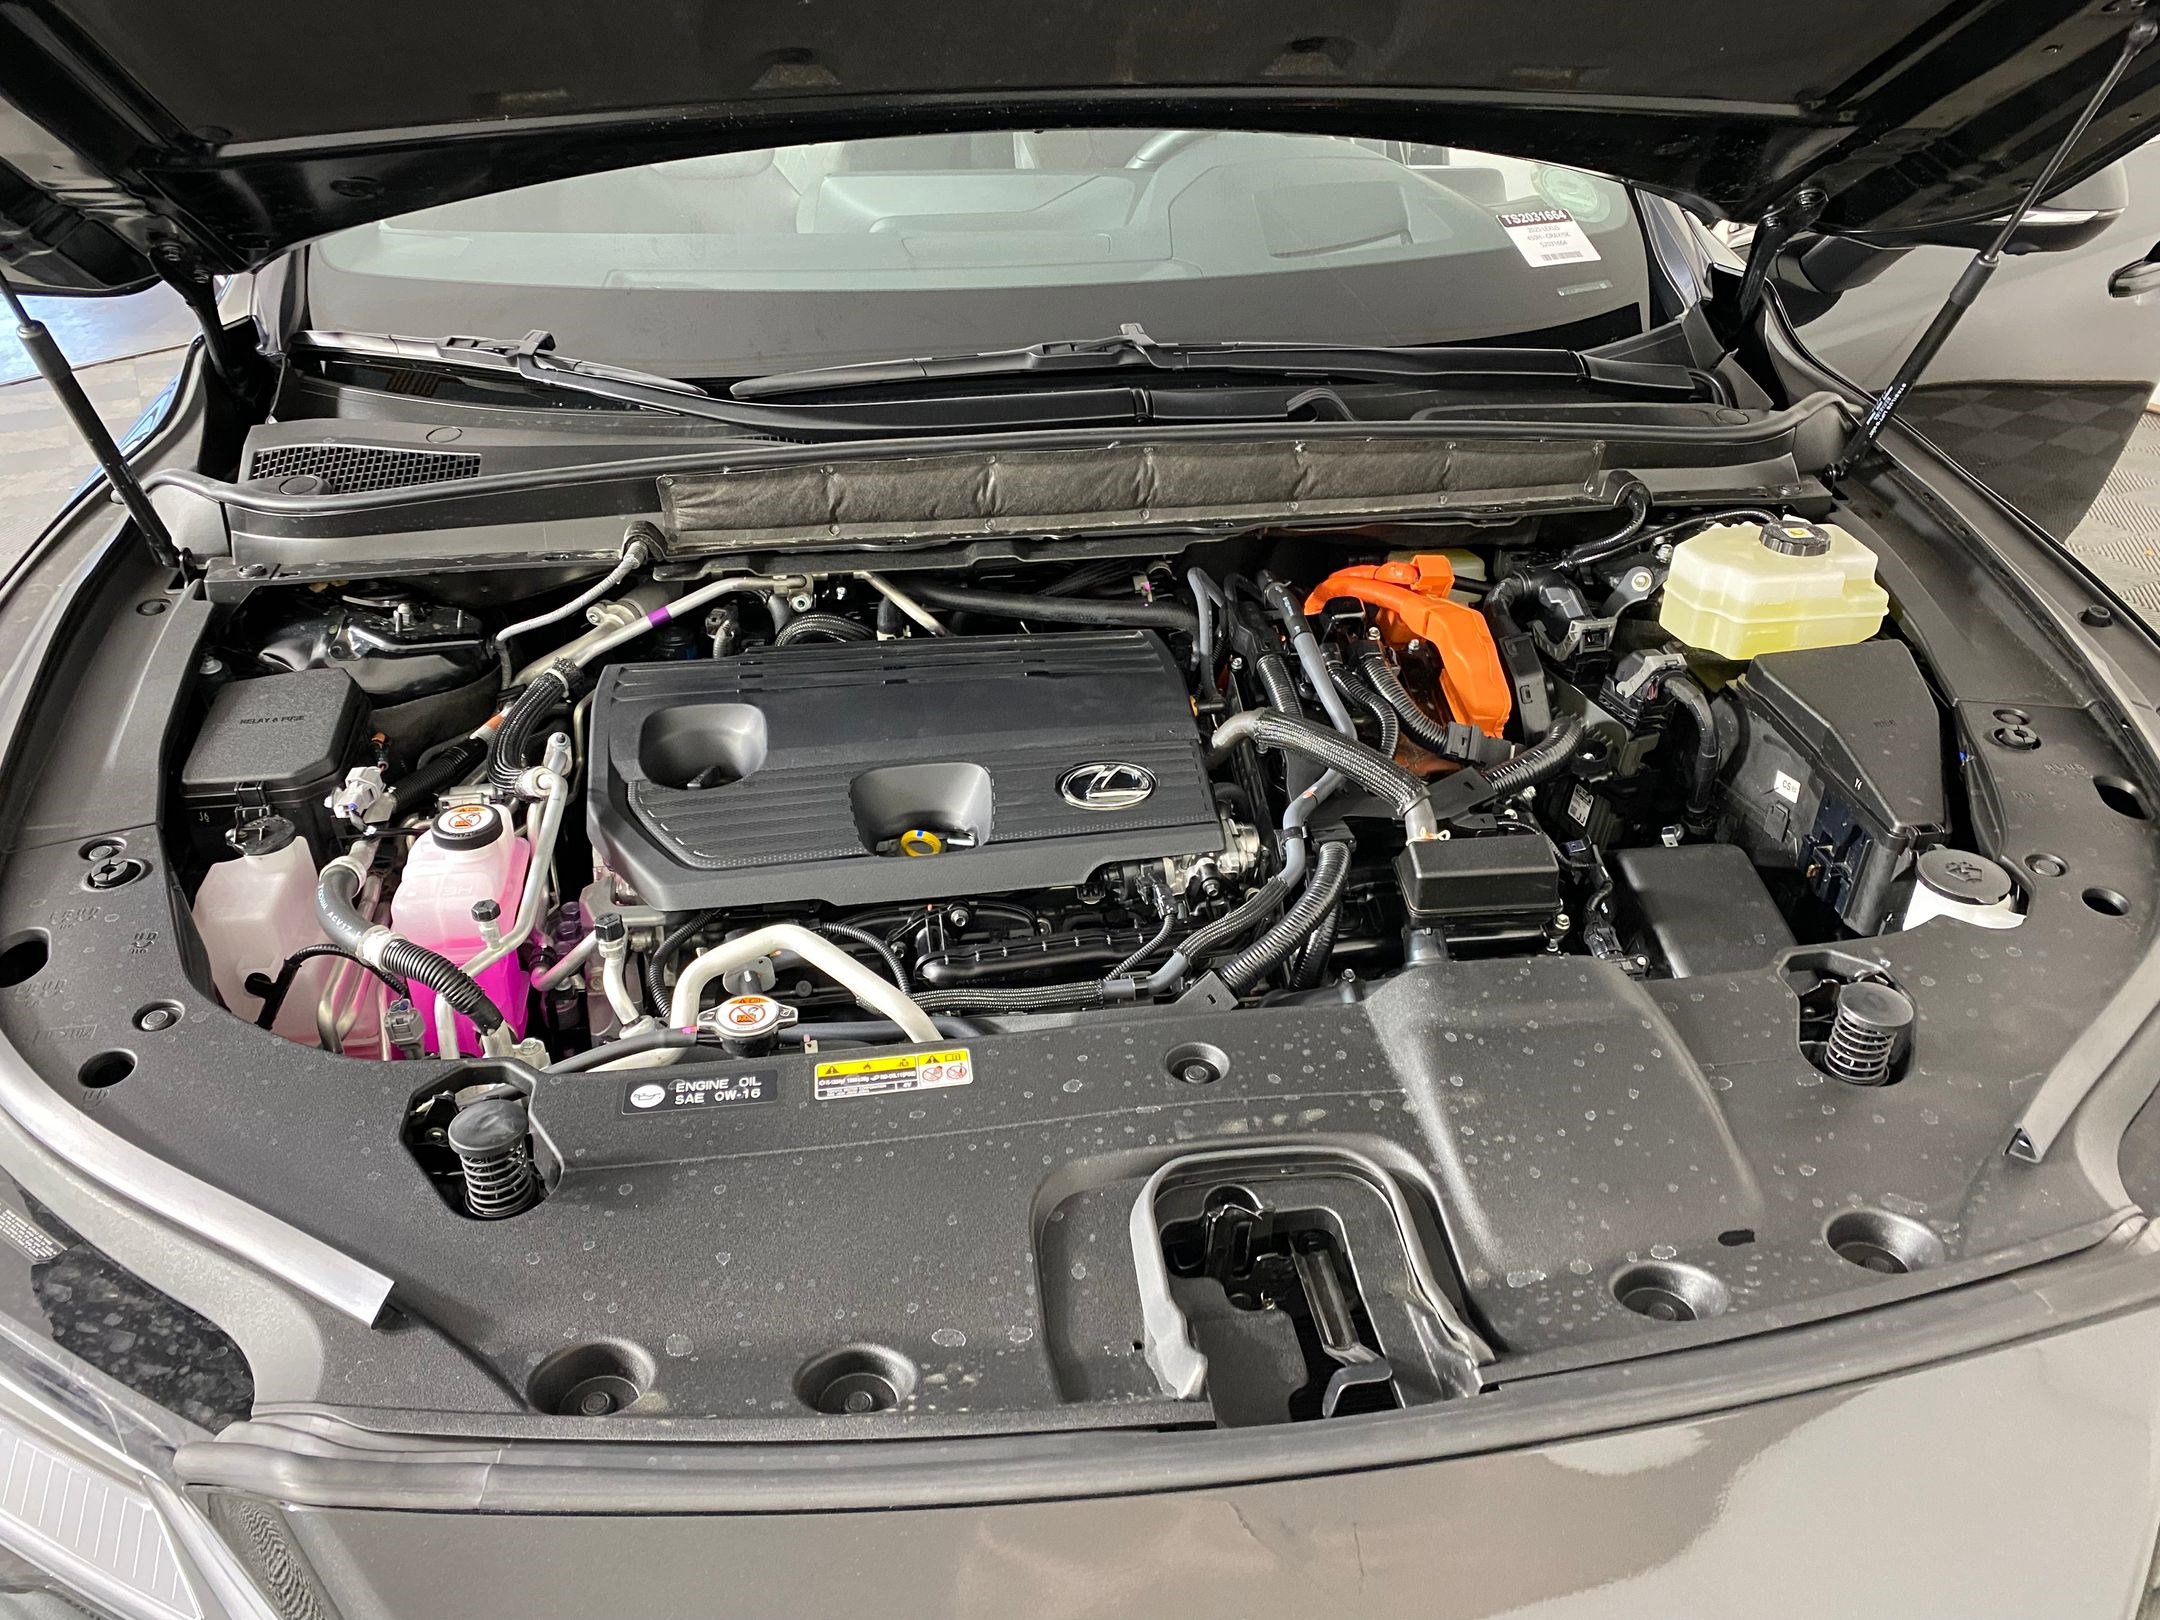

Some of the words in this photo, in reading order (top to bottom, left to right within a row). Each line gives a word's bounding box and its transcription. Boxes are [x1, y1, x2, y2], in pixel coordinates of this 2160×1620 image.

[1502, 209, 1566, 225] TS2031664
[675, 1079, 730, 1093] ENGINE
[738, 1076, 762, 1088] OIL
[674, 1092, 705, 1105] SAE
[714, 1088, 762, 1102] 0W-16
